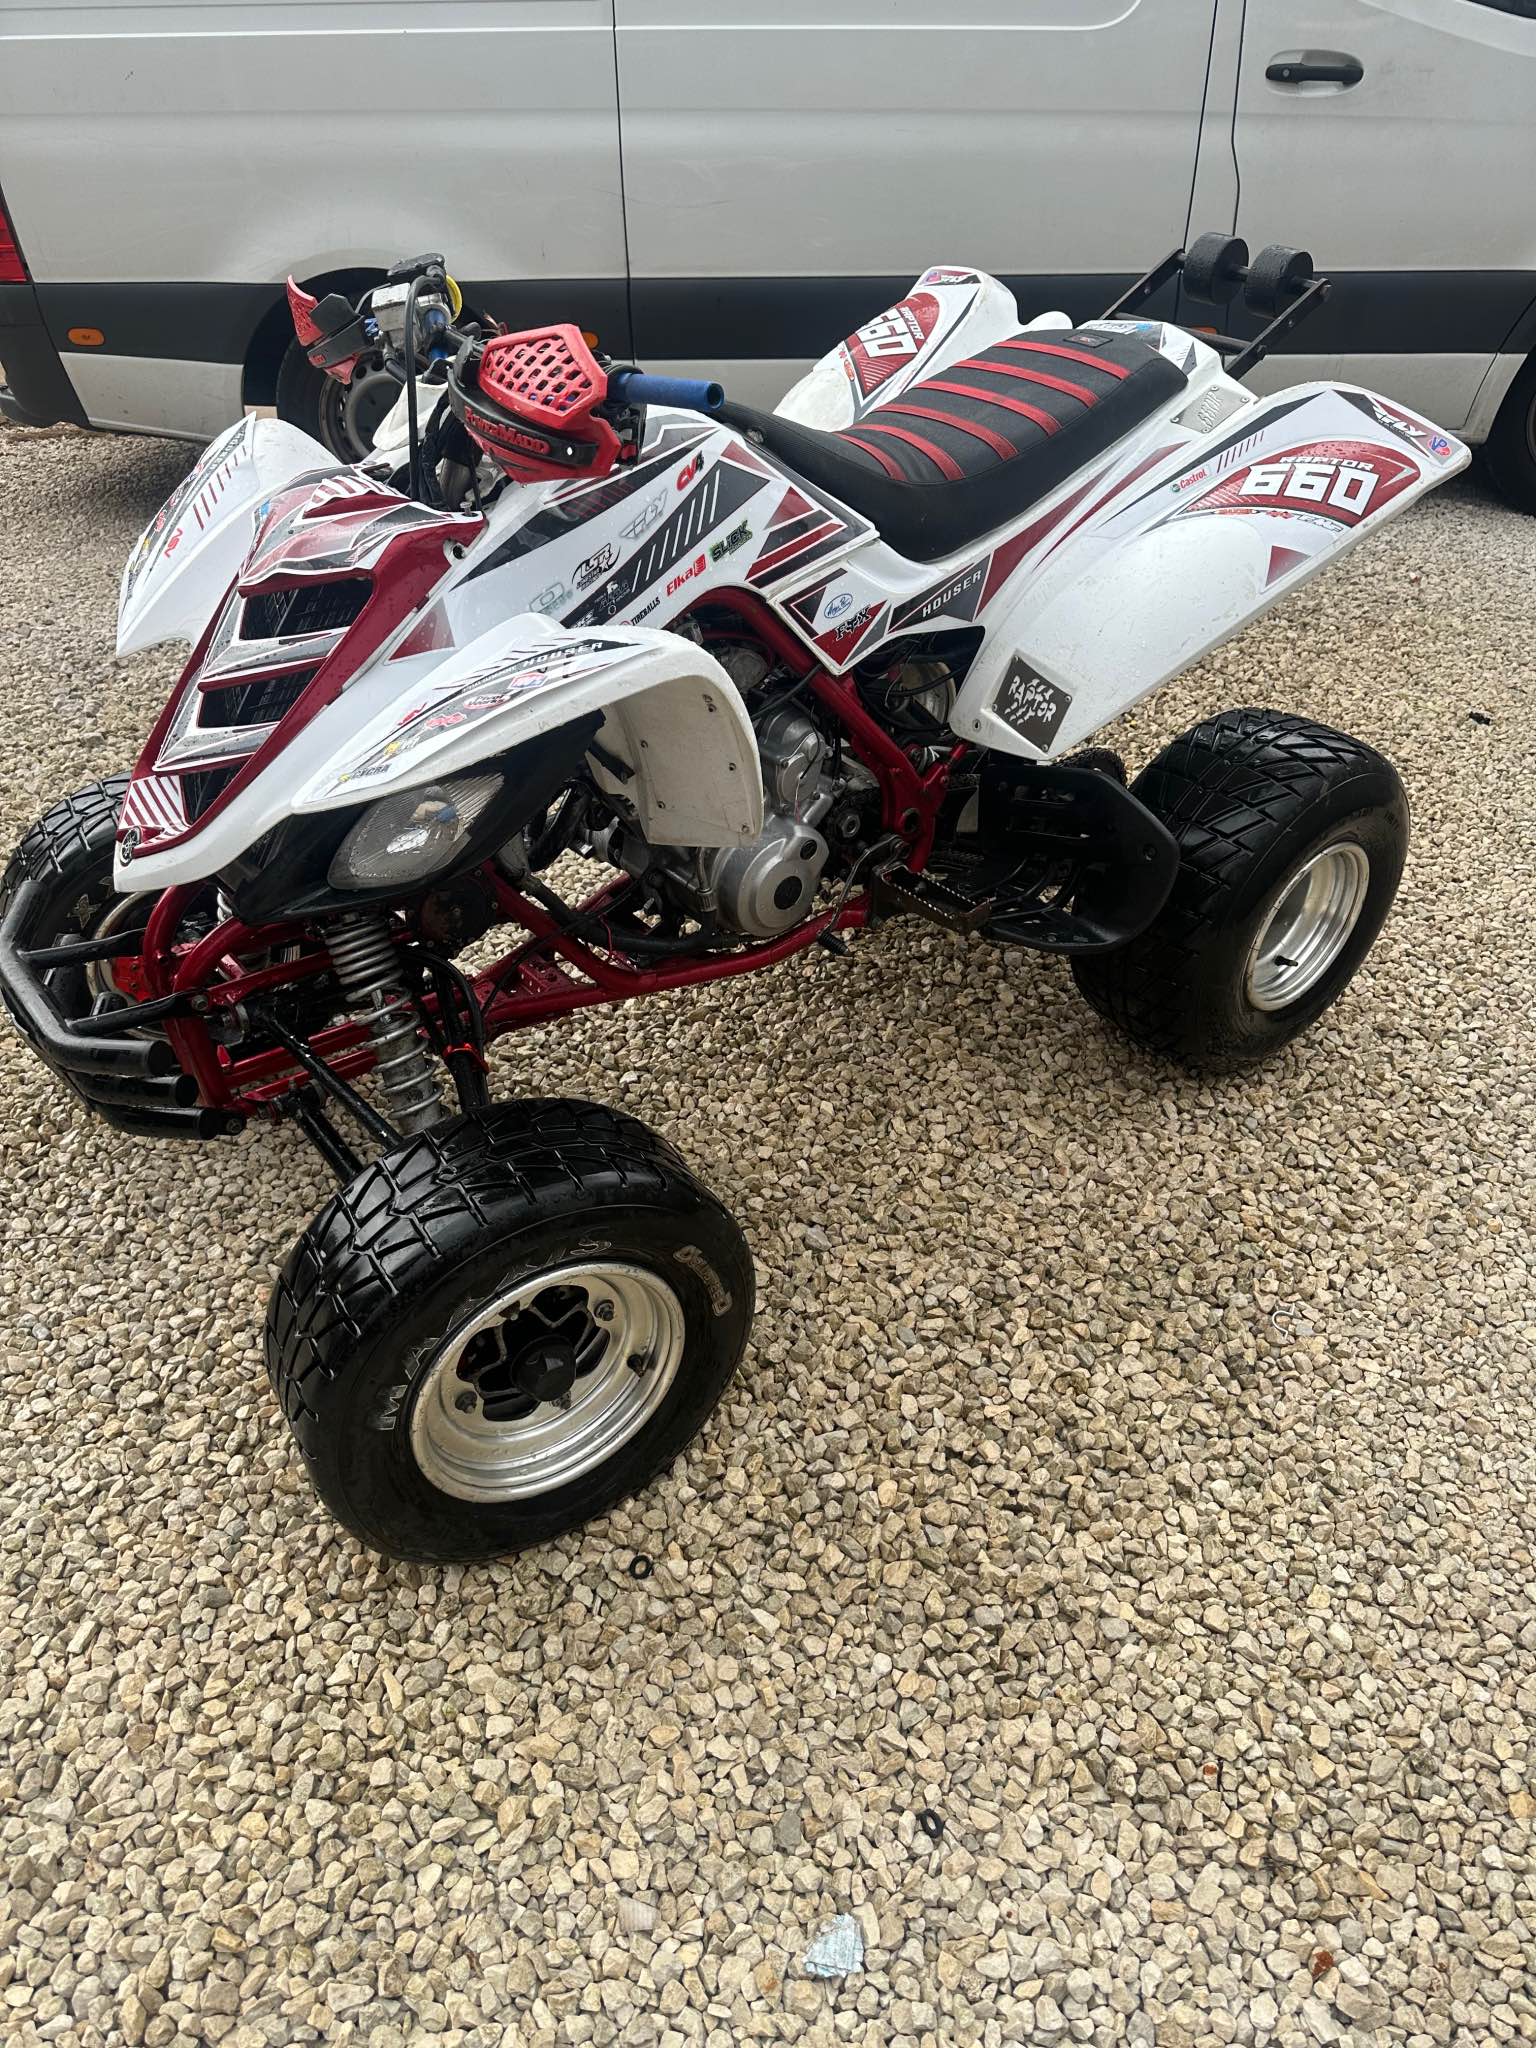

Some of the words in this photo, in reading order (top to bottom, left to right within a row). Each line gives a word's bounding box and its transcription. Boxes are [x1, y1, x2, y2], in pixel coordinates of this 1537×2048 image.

[1180, 468, 1208, 489] Castrol
[1279, 456, 1375, 471] RAPTOR
[1238, 462, 1380, 517] 660
[666, 567, 695, 597] Elka
[922, 569, 982, 618] HOUSER
[630, 596, 661, 626] TIREBALLS
[522, 641, 604, 668] HOUSER
[1008, 675, 1057, 723] RAPTOR
